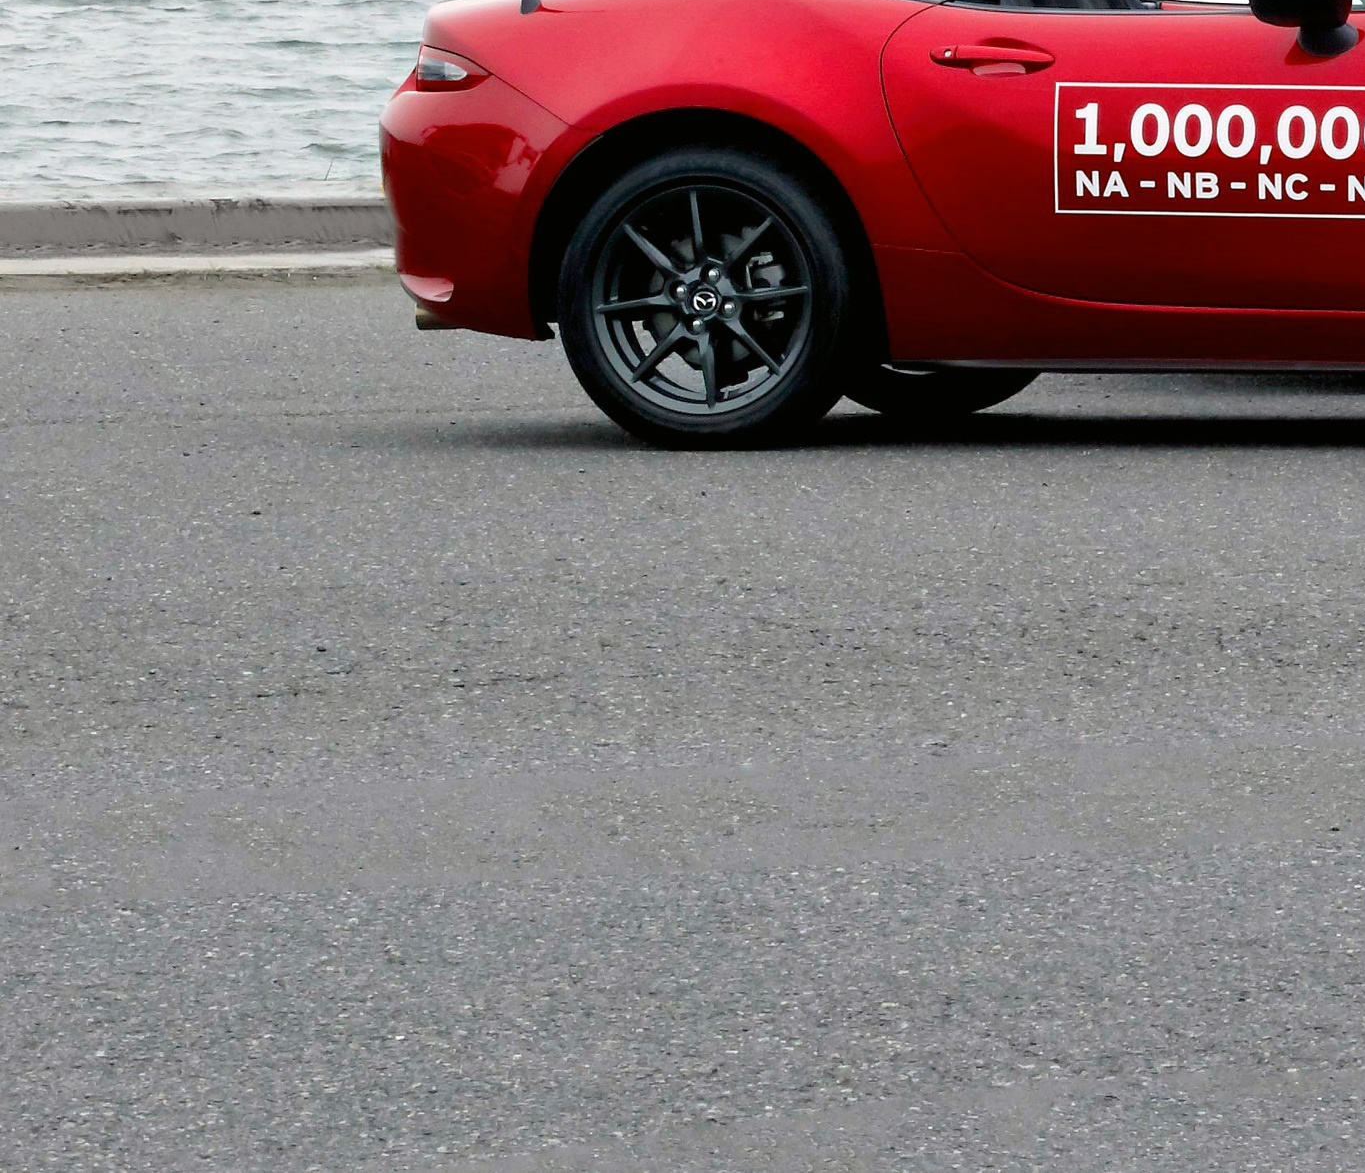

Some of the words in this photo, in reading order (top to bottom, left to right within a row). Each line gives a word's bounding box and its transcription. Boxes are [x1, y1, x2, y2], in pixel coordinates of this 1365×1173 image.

[1075, 169, 1130, 198] NA
[1167, 171, 1220, 199] NB
[1257, 172, 1309, 201] NC
